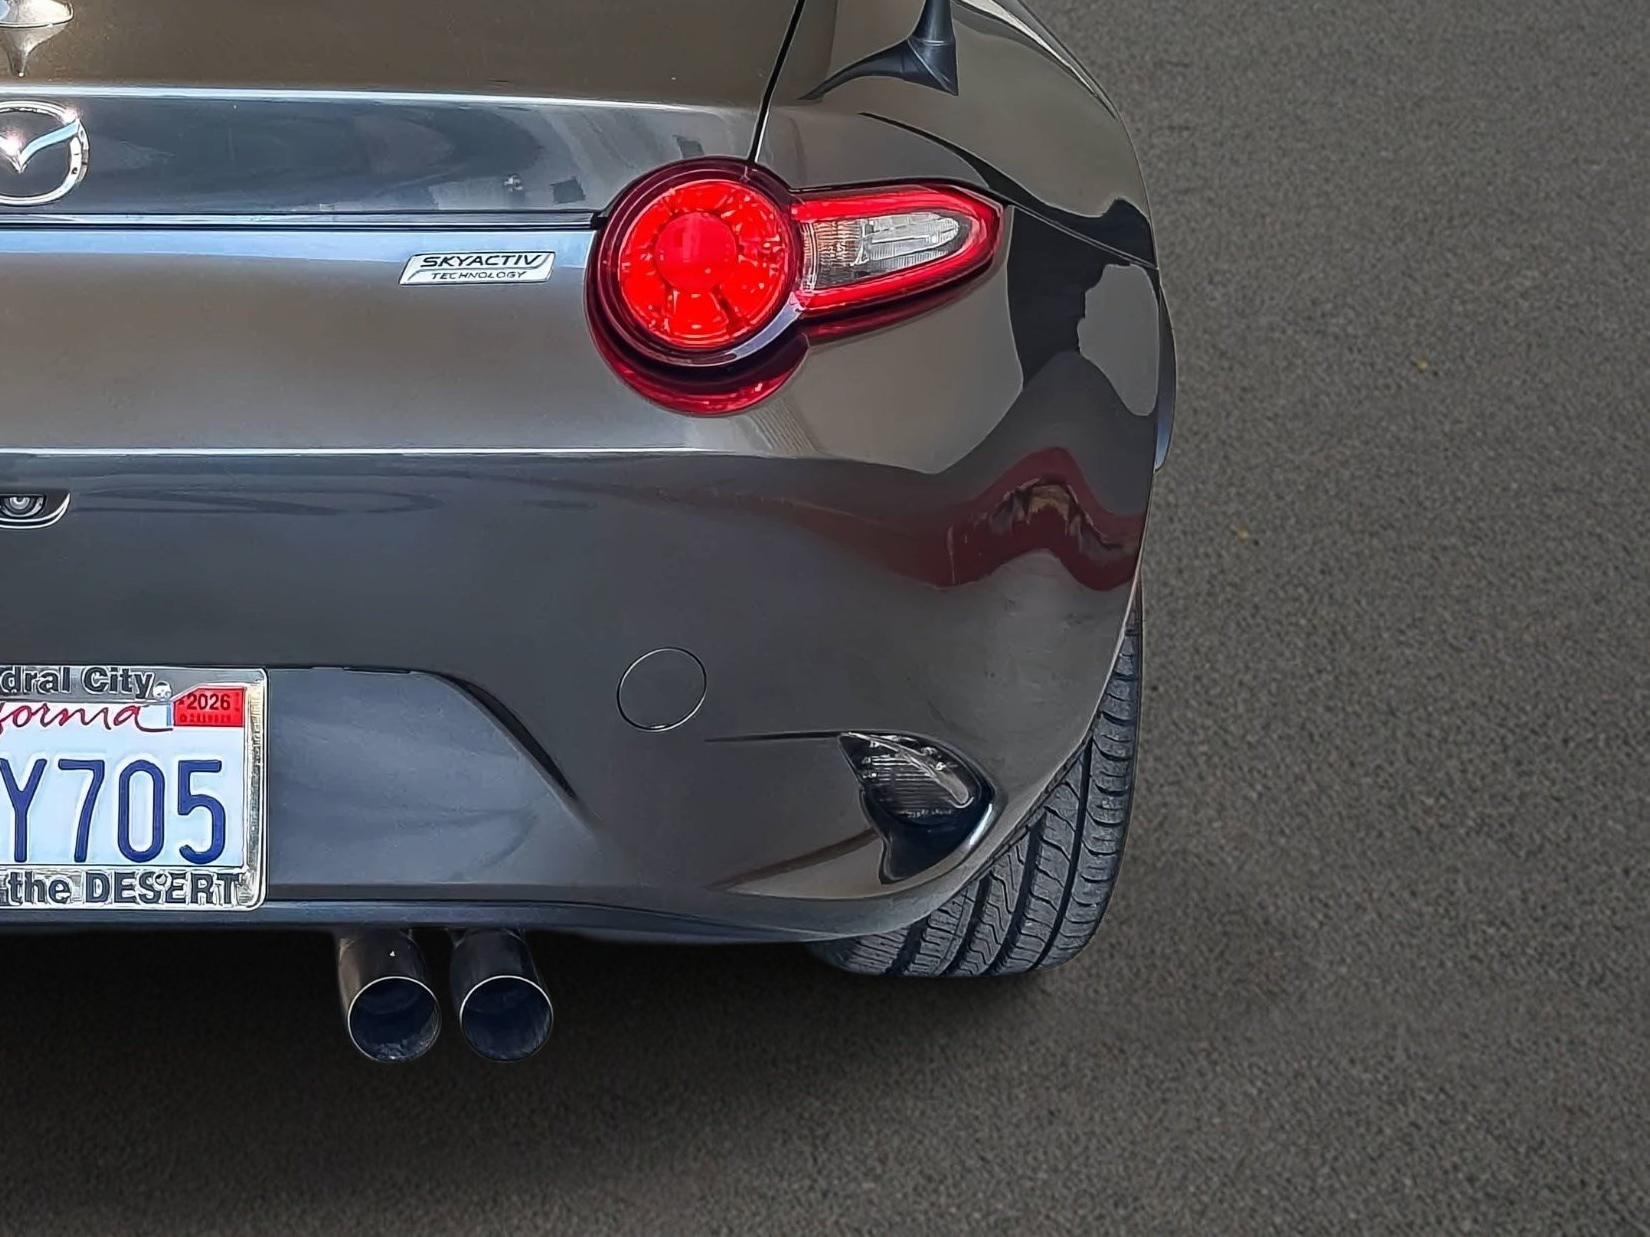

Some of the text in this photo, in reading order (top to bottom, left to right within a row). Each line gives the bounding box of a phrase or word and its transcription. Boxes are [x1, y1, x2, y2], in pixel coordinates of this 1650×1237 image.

[421, 255, 542, 268] SKYACTIV
[431, 271, 527, 280] TECHNOLOGY
[80, 666, 155, 699] City
[186, 693, 230, 711] 2026
[86, 871, 239, 905] DESERT
